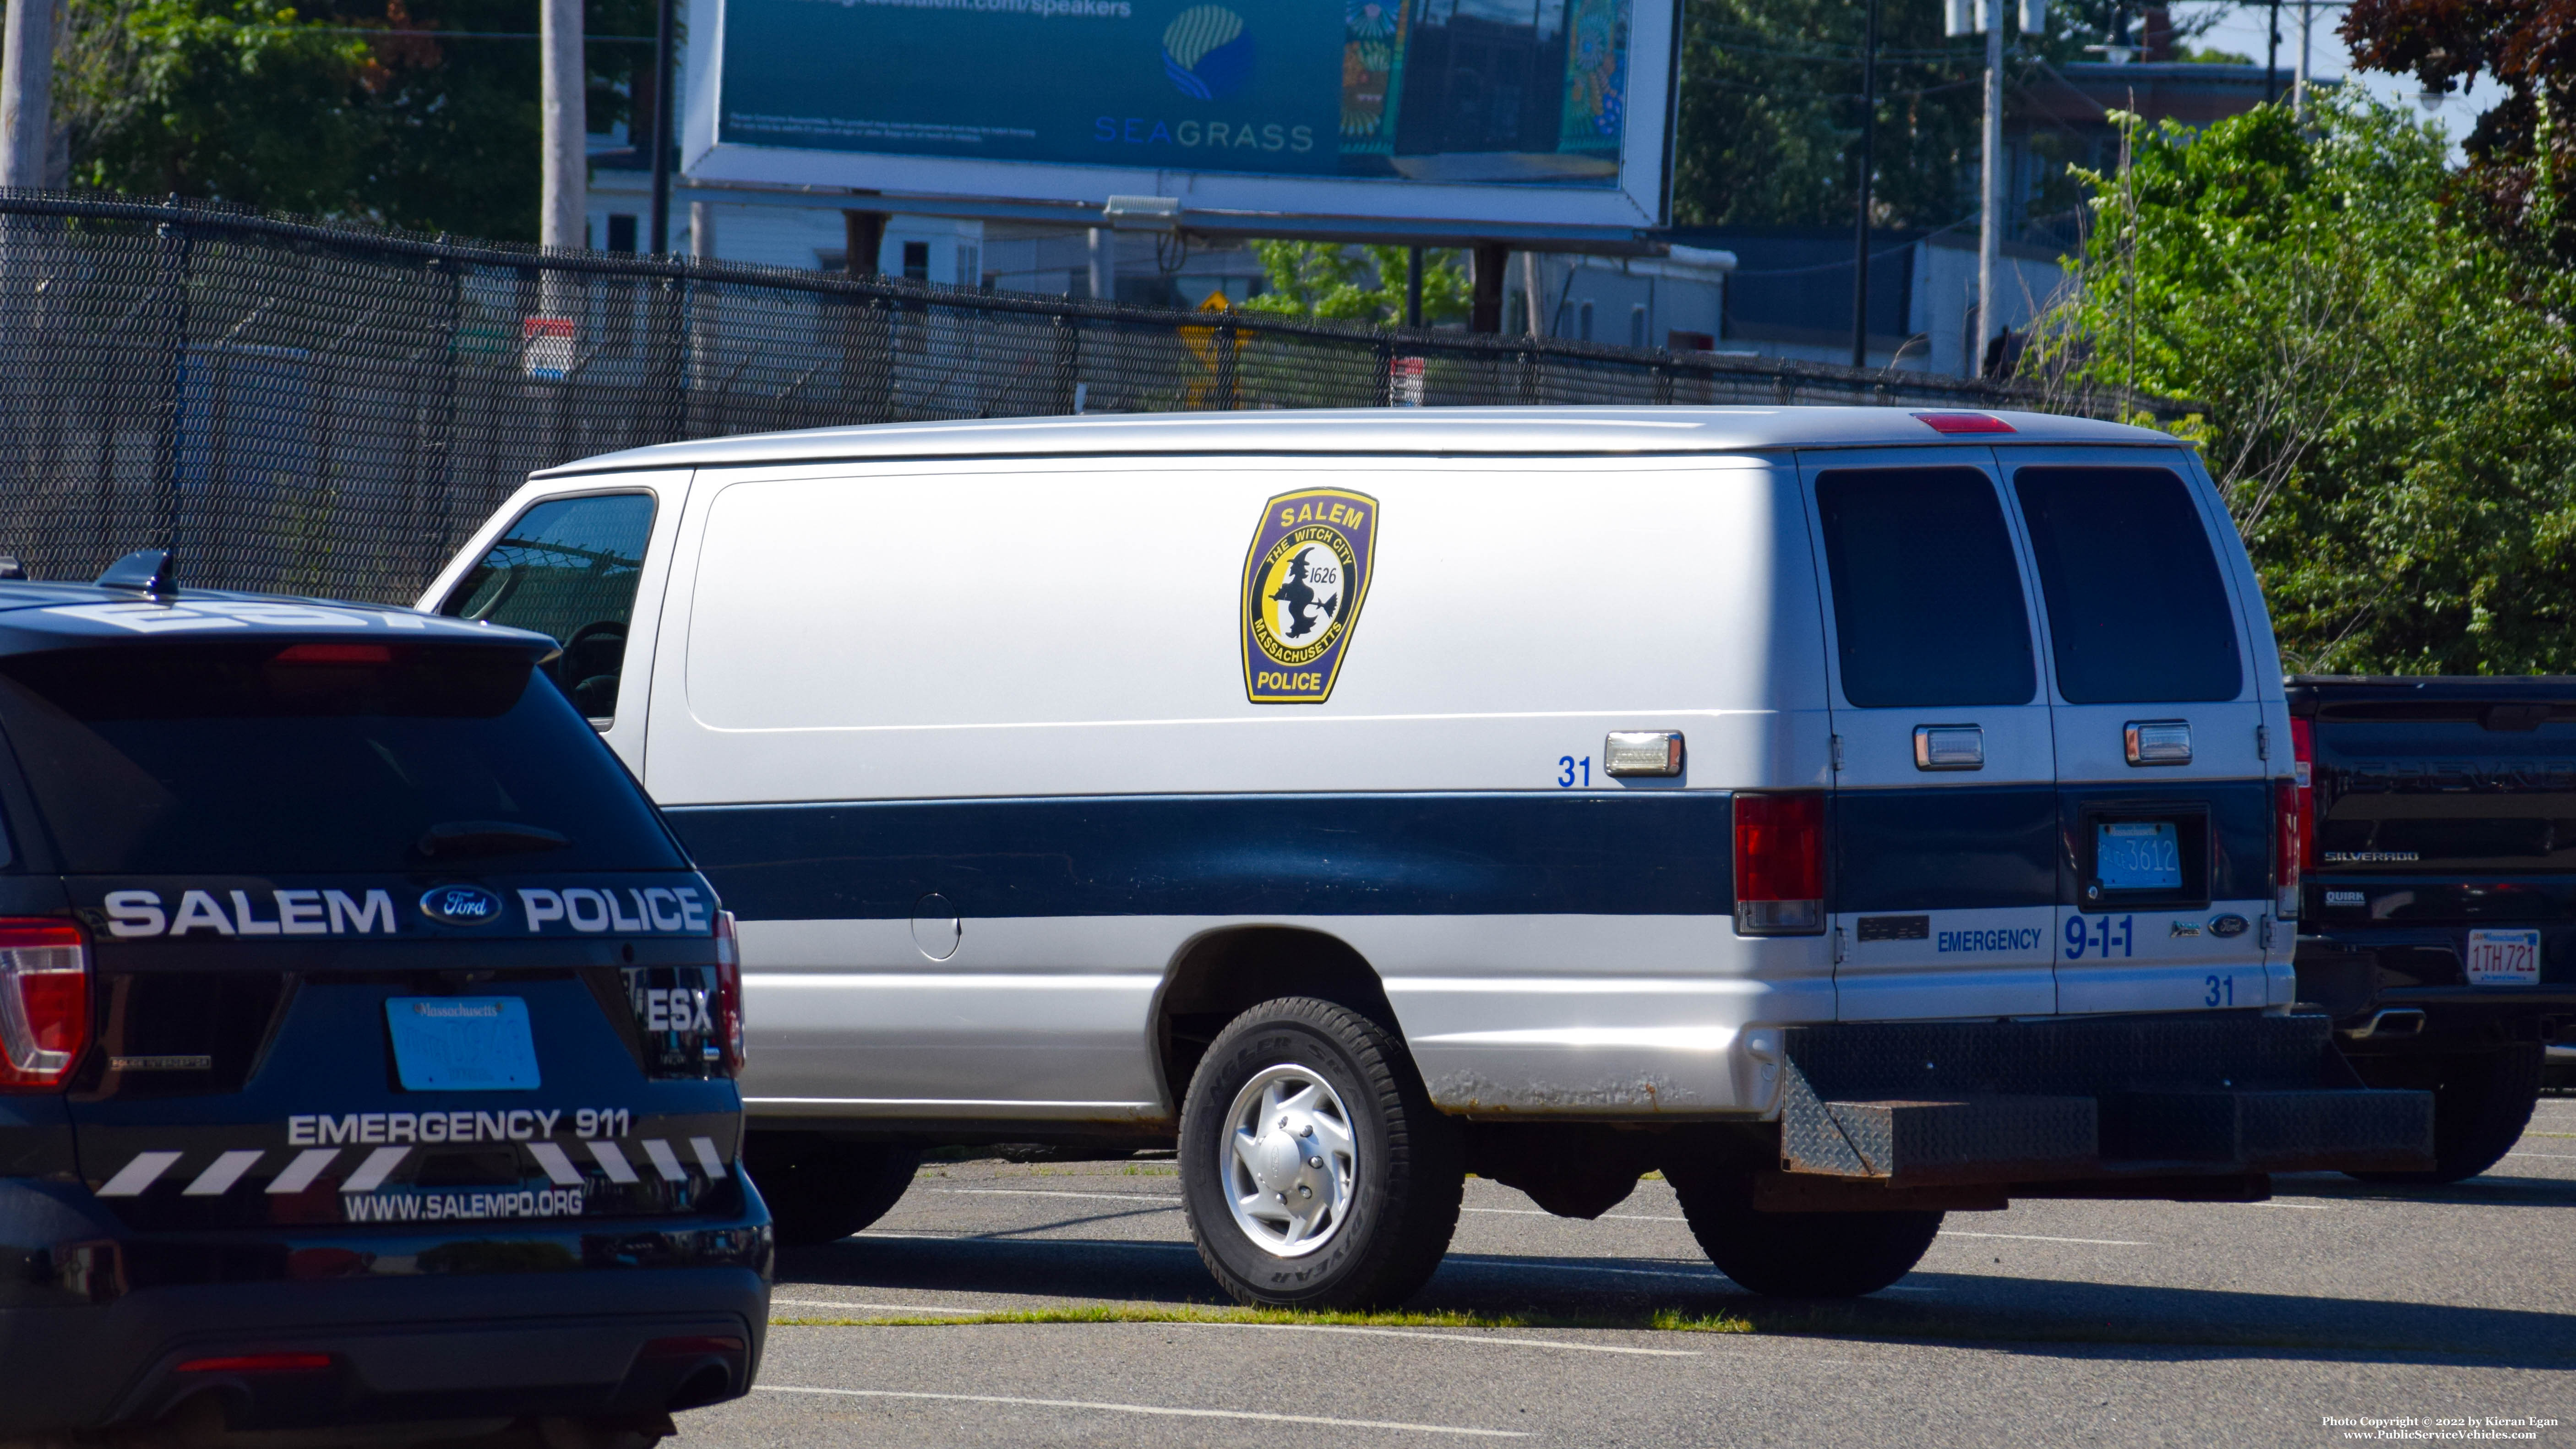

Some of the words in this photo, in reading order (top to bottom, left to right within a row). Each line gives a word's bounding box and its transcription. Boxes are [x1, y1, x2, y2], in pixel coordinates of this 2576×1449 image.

[1095, 116, 1313, 153] SEAGRASS
[1281, 502, 1364, 530] SALEM
[1267, 539, 1291, 566] THE
[1295, 528, 1332, 542] WITCH
[1332, 538, 1352, 566] CITY
[1309, 567, 1337, 584] 1626
[1254, 618, 1343, 663] MASSACHUSETTS
[1257, 672, 1322, 690] POLICE
[1558, 756, 1590, 787] 31
[2126, 839, 2176, 871] 3612
[2325, 851, 2419, 861] SILVERADO
[443, 891, 487, 916] Ford
[517, 887, 708, 933] POLICE
[2326, 891, 2365, 902] QUIRK
[104, 889, 396, 937] SALEM
[1938, 928, 2042, 952] EMERGENCY
[2065, 915, 2133, 959] 9-1-1
[2473, 945, 2503, 971] 1TH
[2507, 945, 2536, 971] 721
[2205, 975, 2233, 1007] 31
[419, 1002, 498, 1017] Massachusetts
[648, 988, 713, 1032] ESX
[289, 1109, 561, 1145] EMERGENCY
[576, 1108, 629, 1138] 911
[345, 1189, 584, 1222] WWW.SALEMPD.ORG
